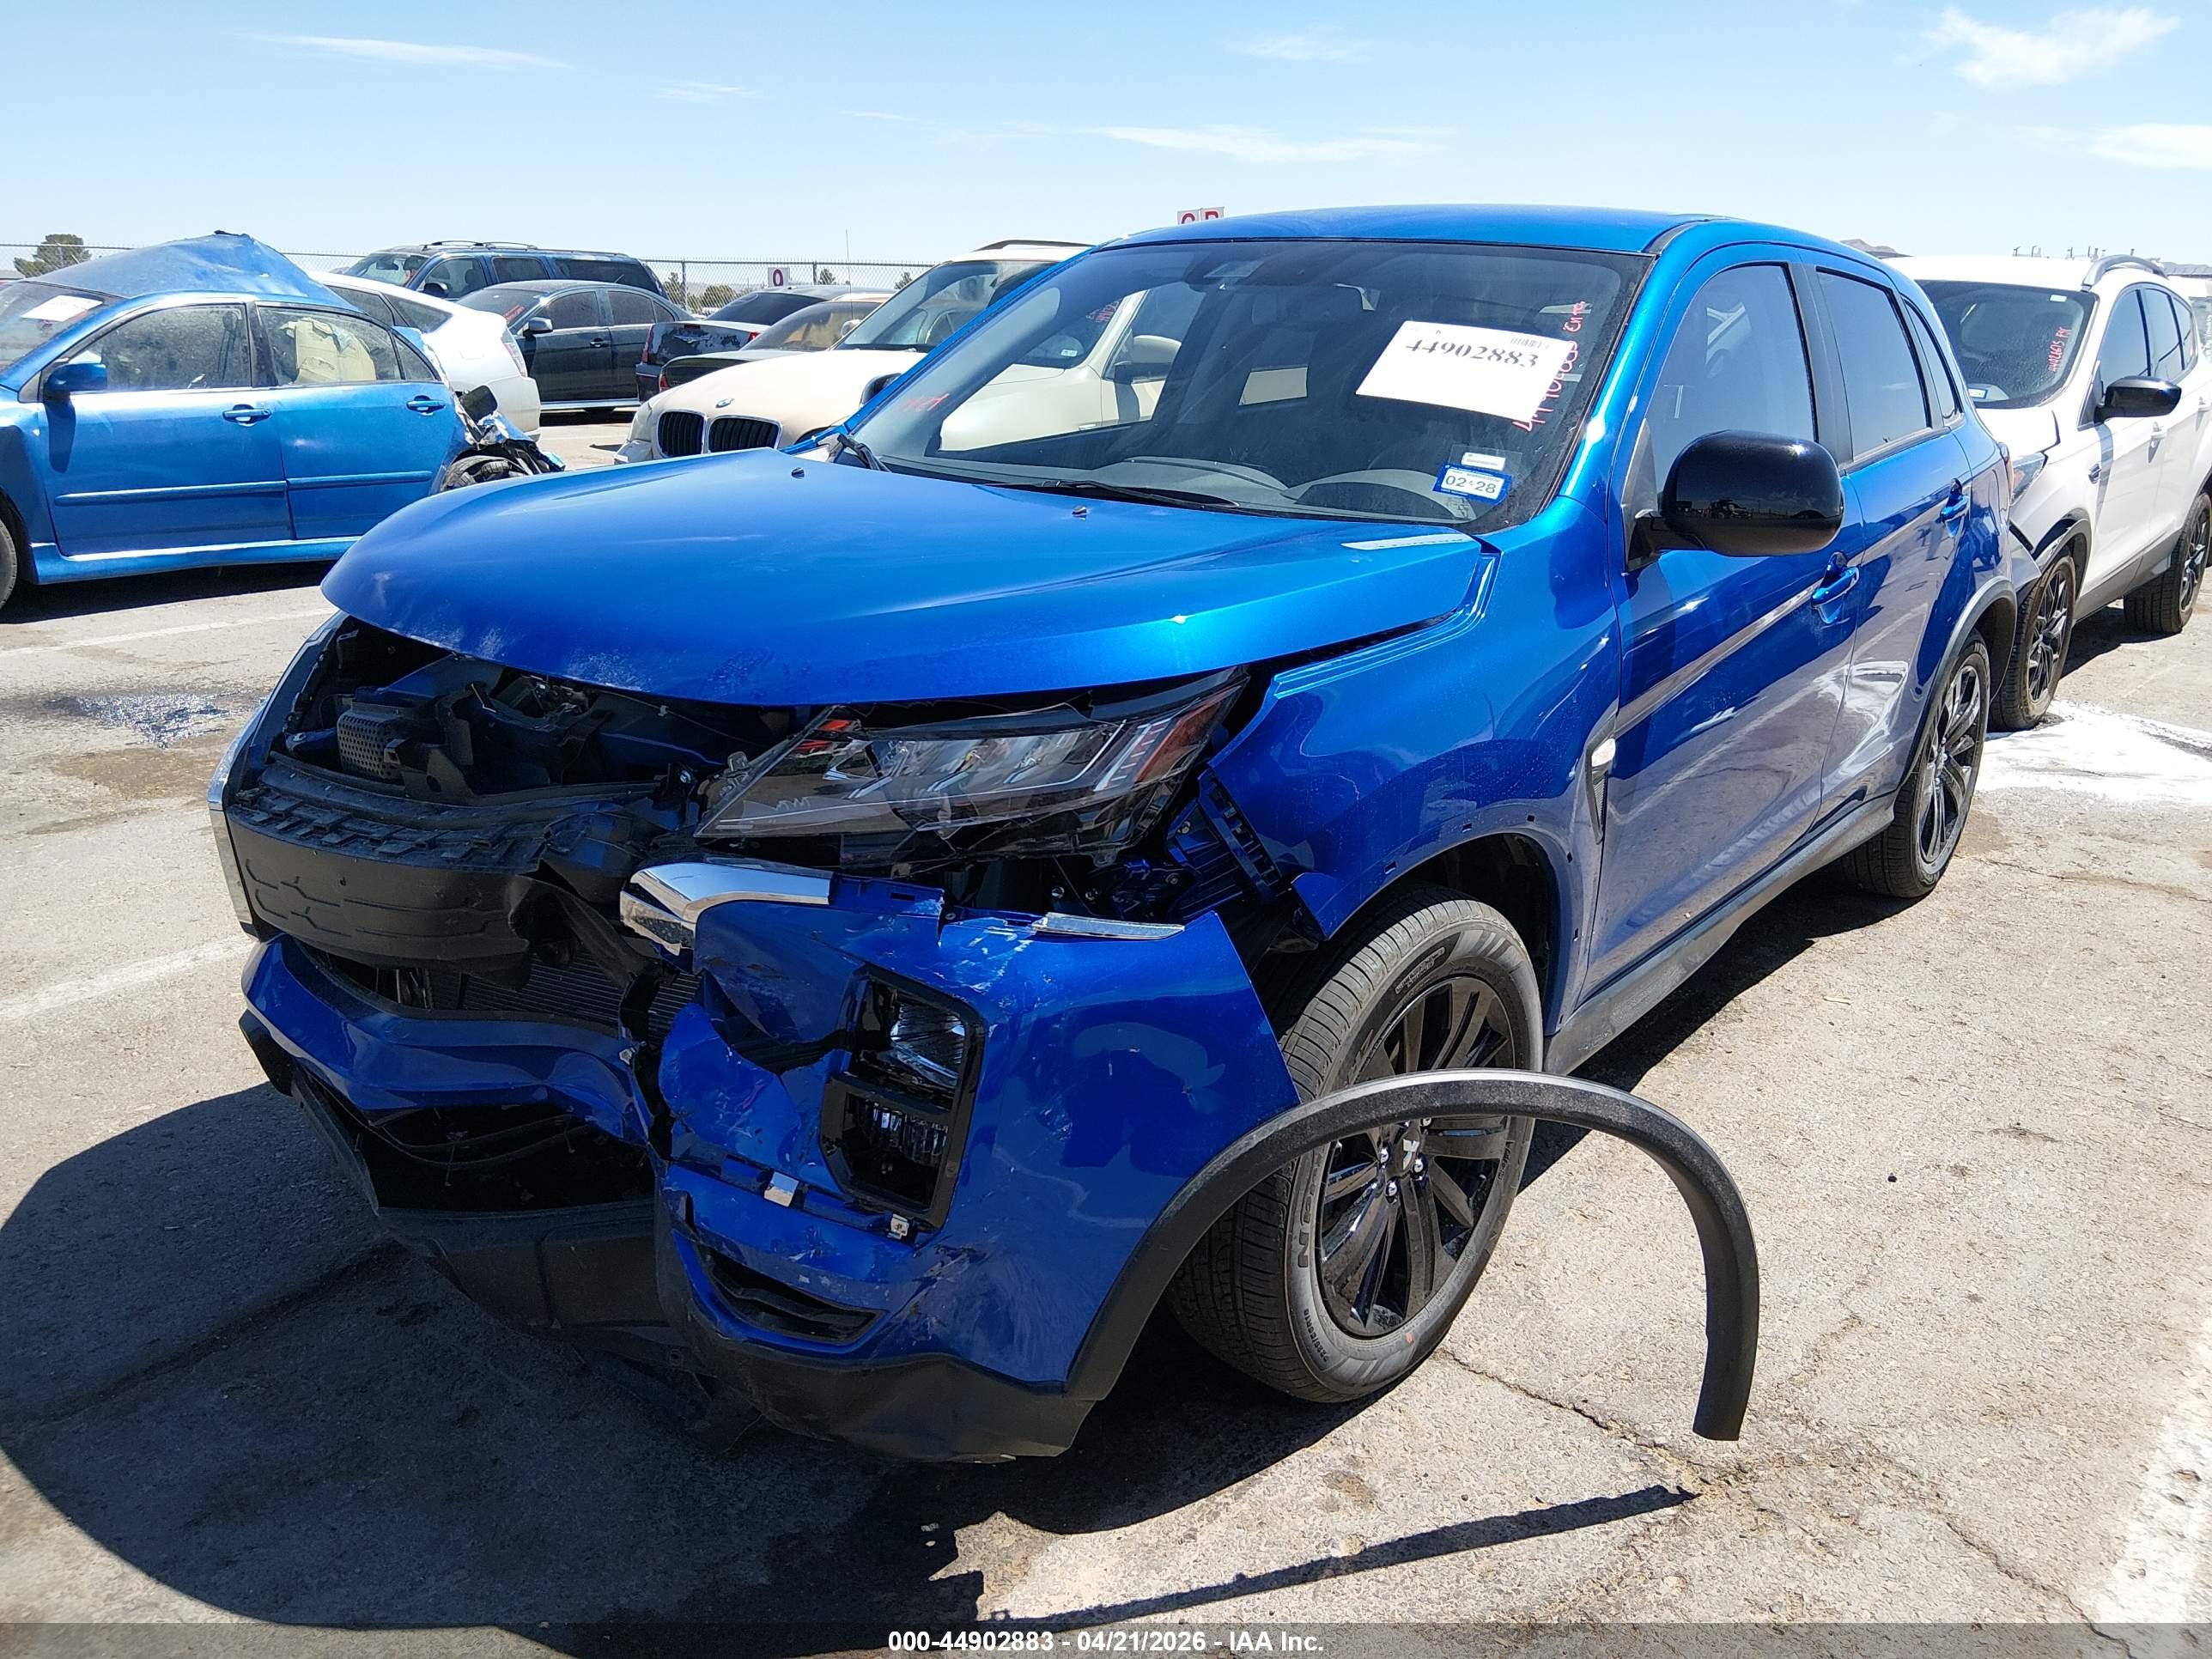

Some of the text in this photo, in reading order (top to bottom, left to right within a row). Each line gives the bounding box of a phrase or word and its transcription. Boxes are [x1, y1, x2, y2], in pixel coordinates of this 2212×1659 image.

[1406, 339, 1540, 368] 44902883
[1445, 475, 1468, 488] 02
[1474, 481, 1497, 494] 28
